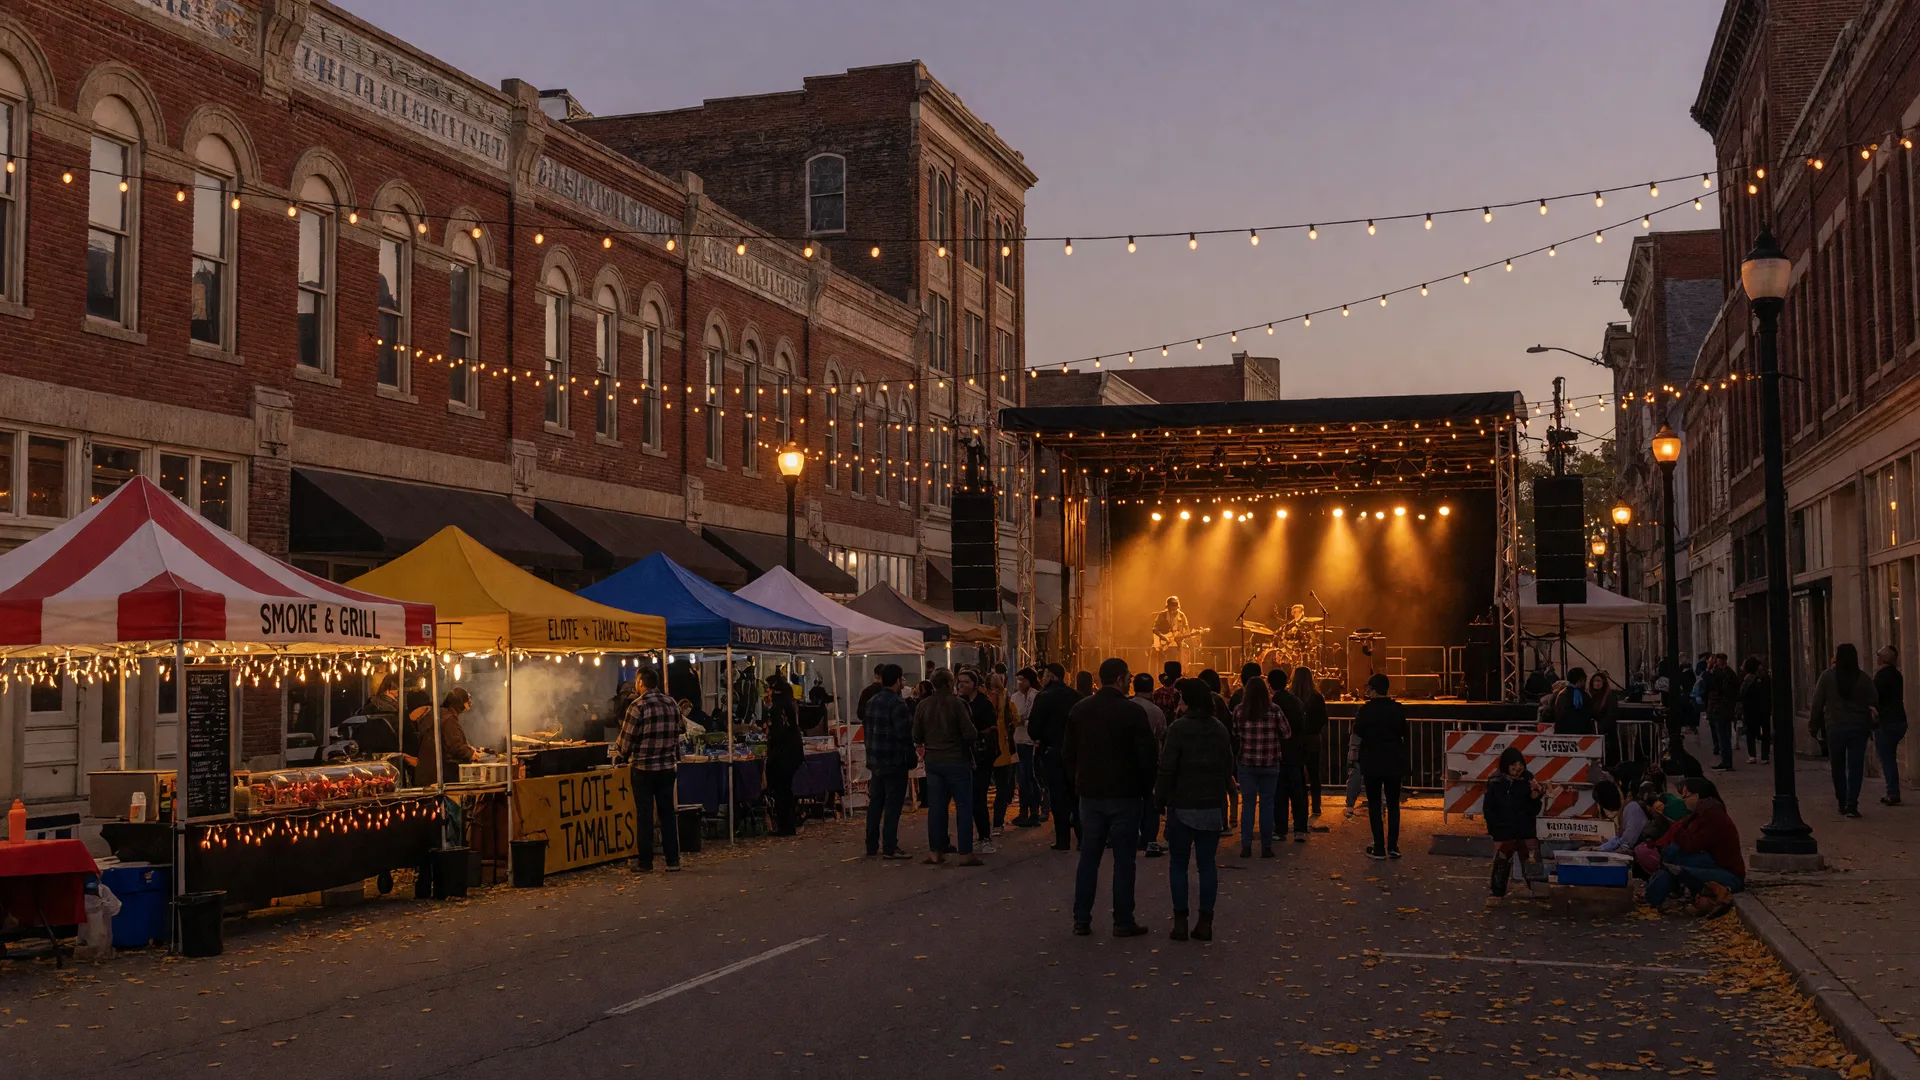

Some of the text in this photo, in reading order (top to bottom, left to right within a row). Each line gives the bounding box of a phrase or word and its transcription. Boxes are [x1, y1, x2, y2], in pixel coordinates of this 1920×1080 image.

[260, 603, 381, 639] SMOKE & GRILL
[548, 618, 579, 641] ELOTE
[592, 619, 631, 642] TAMALES
[761, 629, 791, 646] PICKLES
[558, 774, 629, 819] ELOTE +
[560, 811, 635, 862] TAMALES
